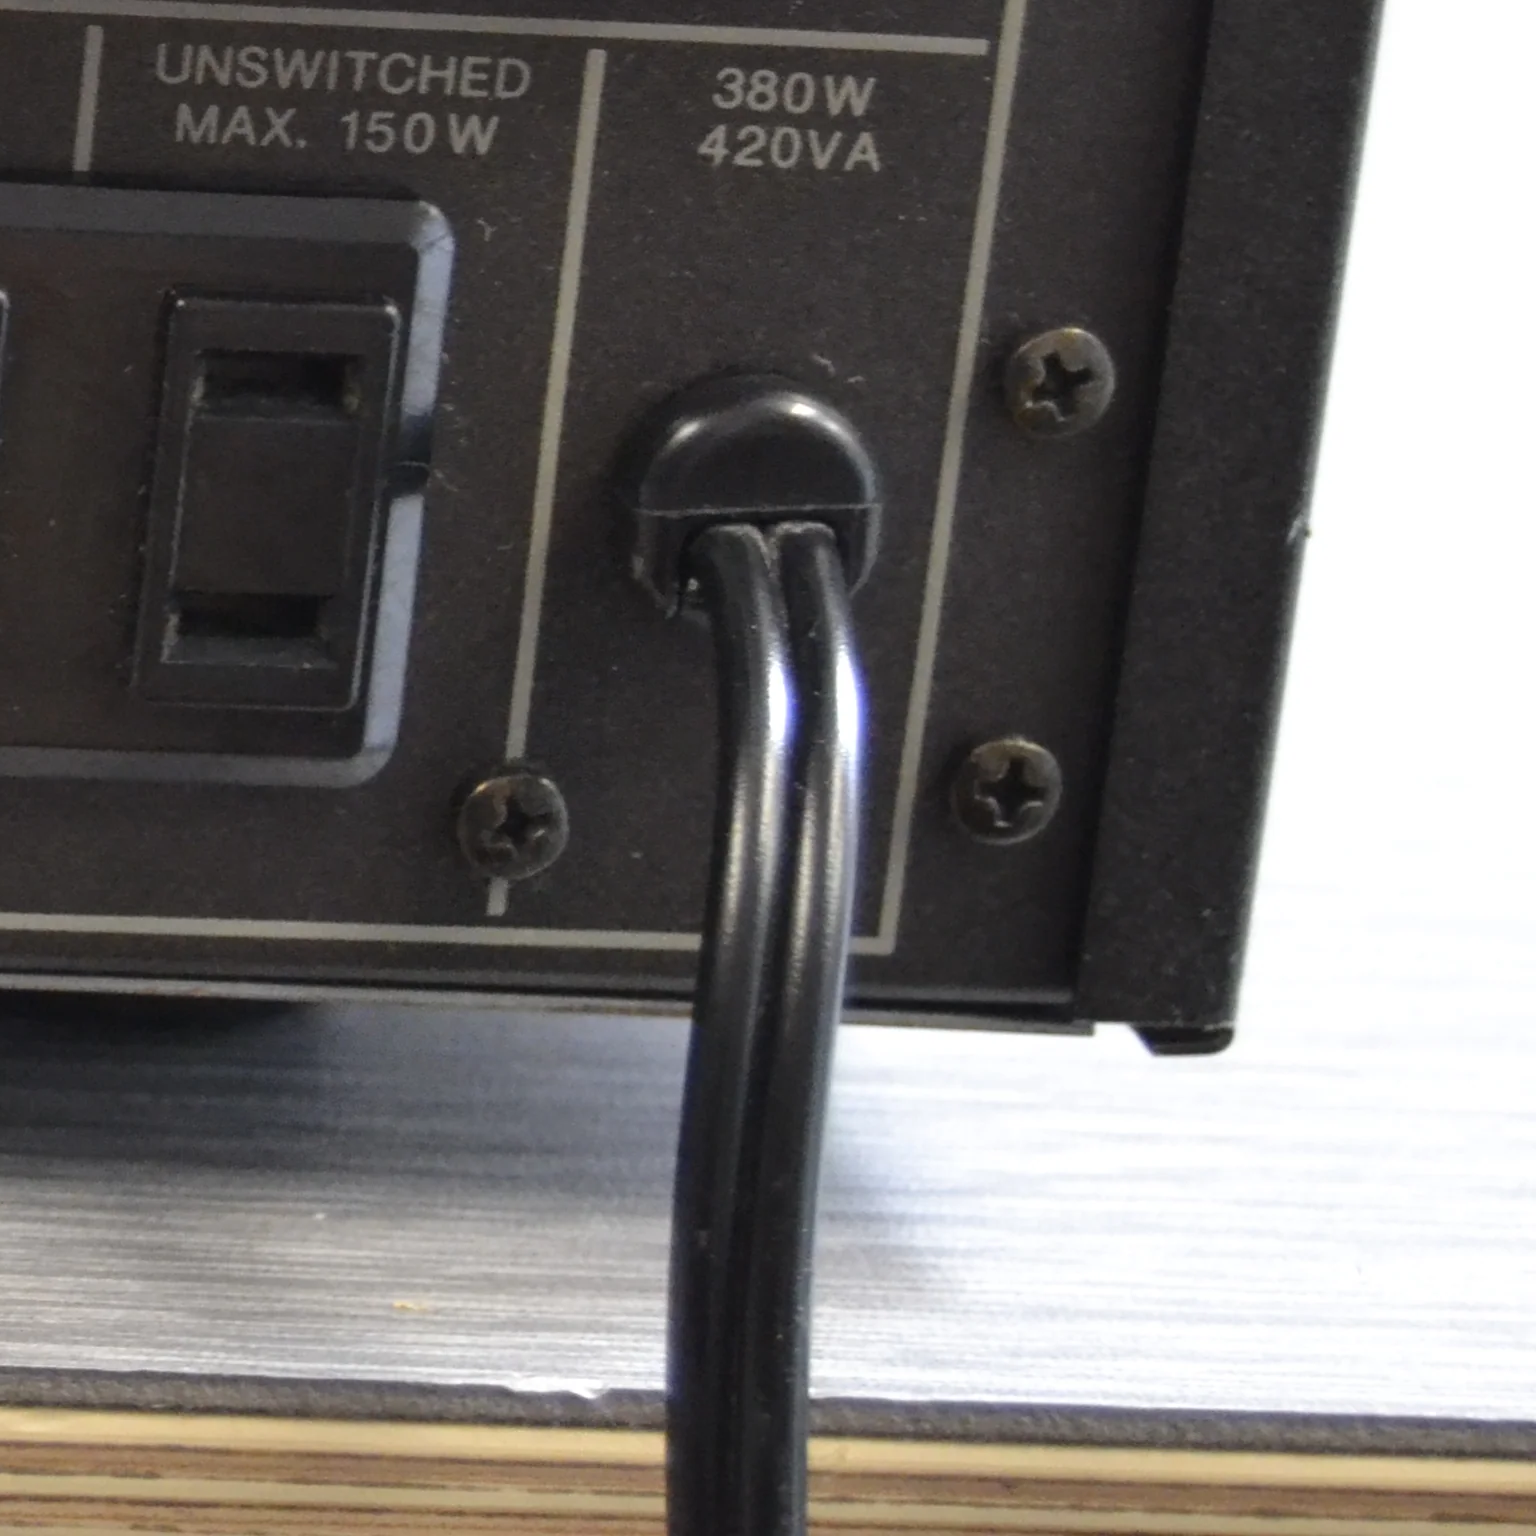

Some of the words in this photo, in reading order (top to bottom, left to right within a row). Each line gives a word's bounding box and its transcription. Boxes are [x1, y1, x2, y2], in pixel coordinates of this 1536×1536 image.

[156, 41, 532, 100] UNSWITCHED
[712, 68, 877, 118] 380W
[175, 103, 308, 149] MAX.
[698, 123, 881, 175] 420VA
